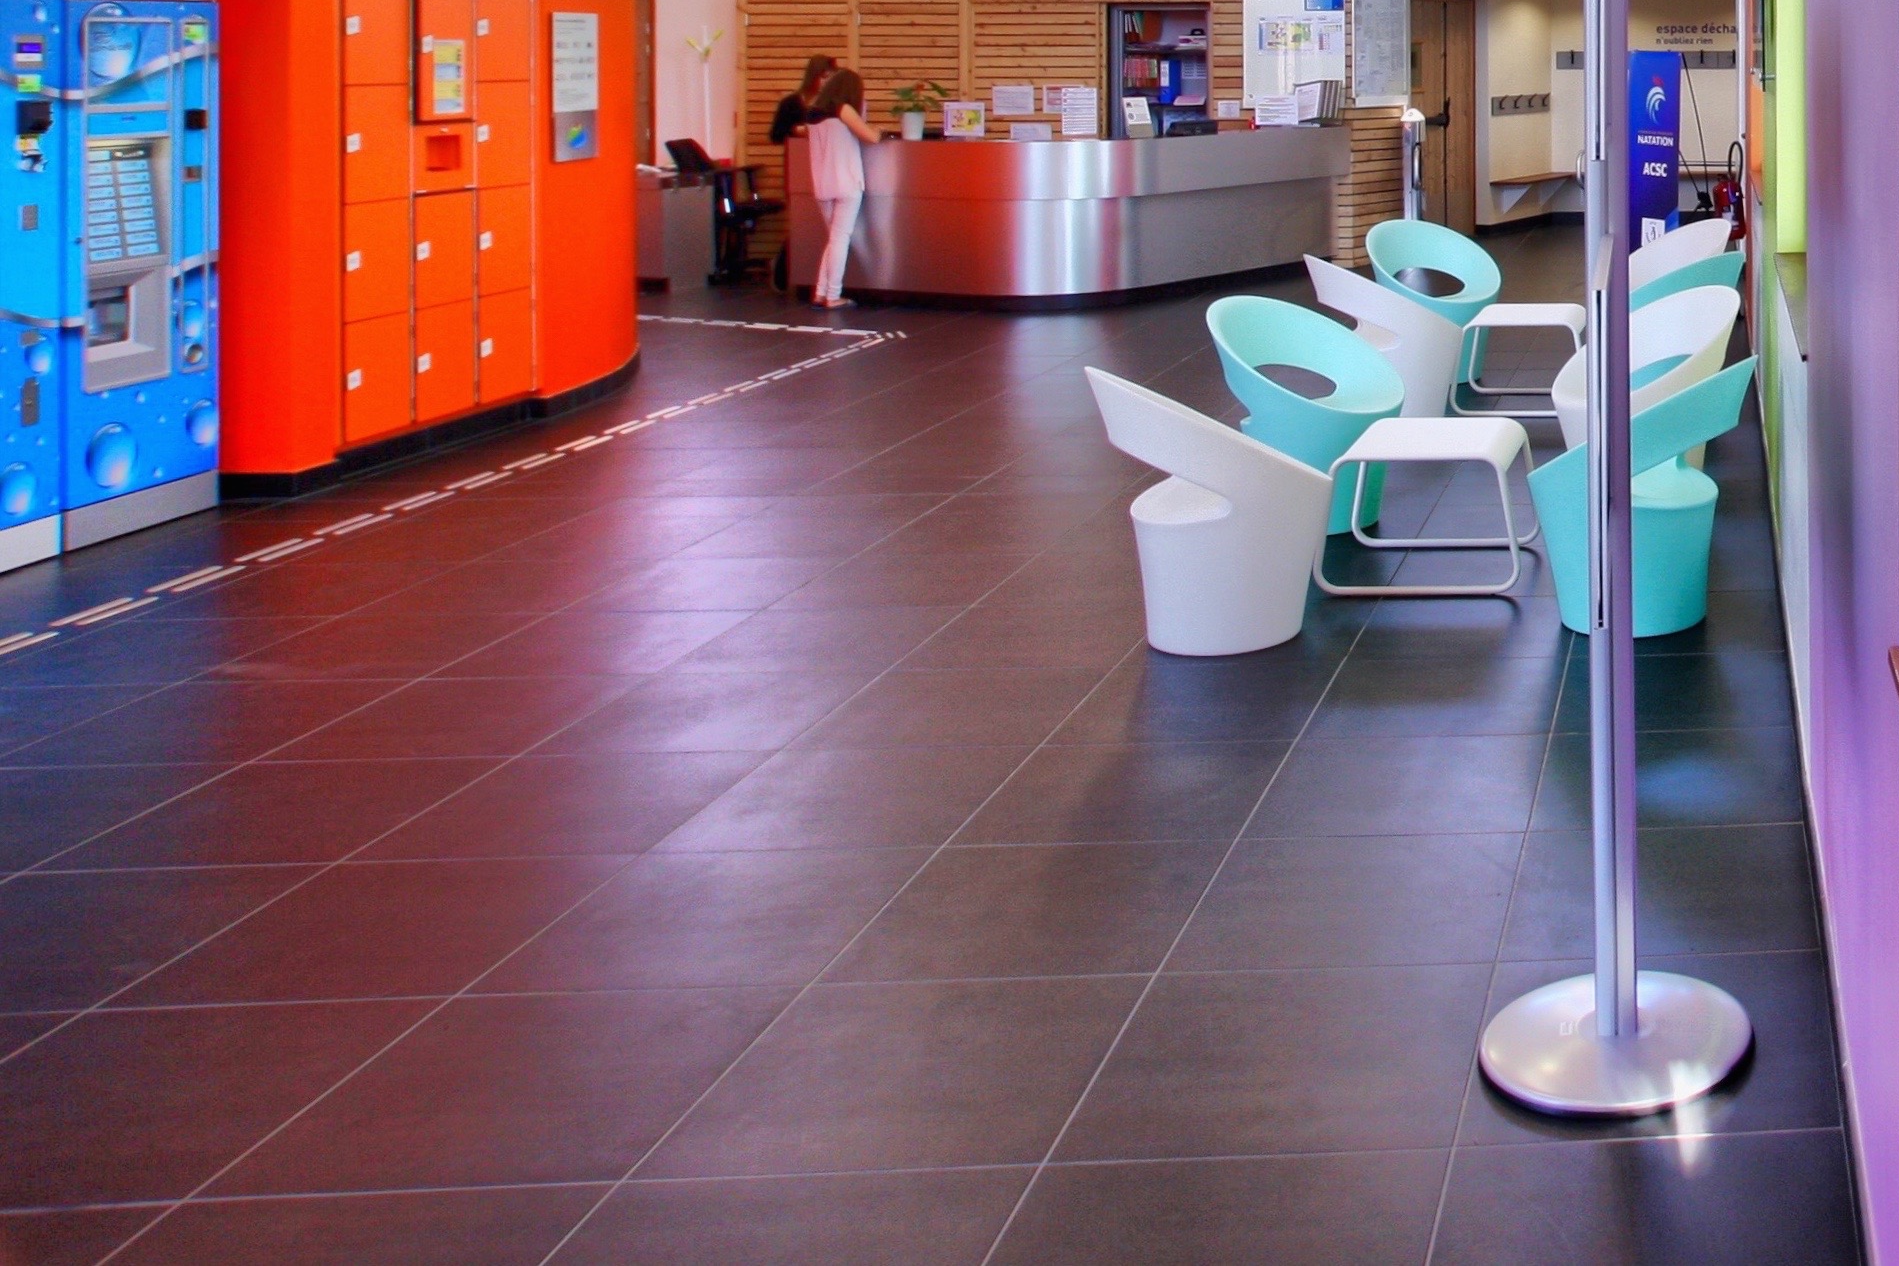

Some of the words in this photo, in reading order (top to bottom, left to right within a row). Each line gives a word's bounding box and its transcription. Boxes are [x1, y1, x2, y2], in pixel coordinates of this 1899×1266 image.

[1656, 24, 1698, 35] espace
[1656, 37, 1694, 45] n'oubliez
[1696, 37, 1713, 45] rien
[1637, 135, 1674, 146] NATATION
[1643, 162, 1668, 177] ACSC
